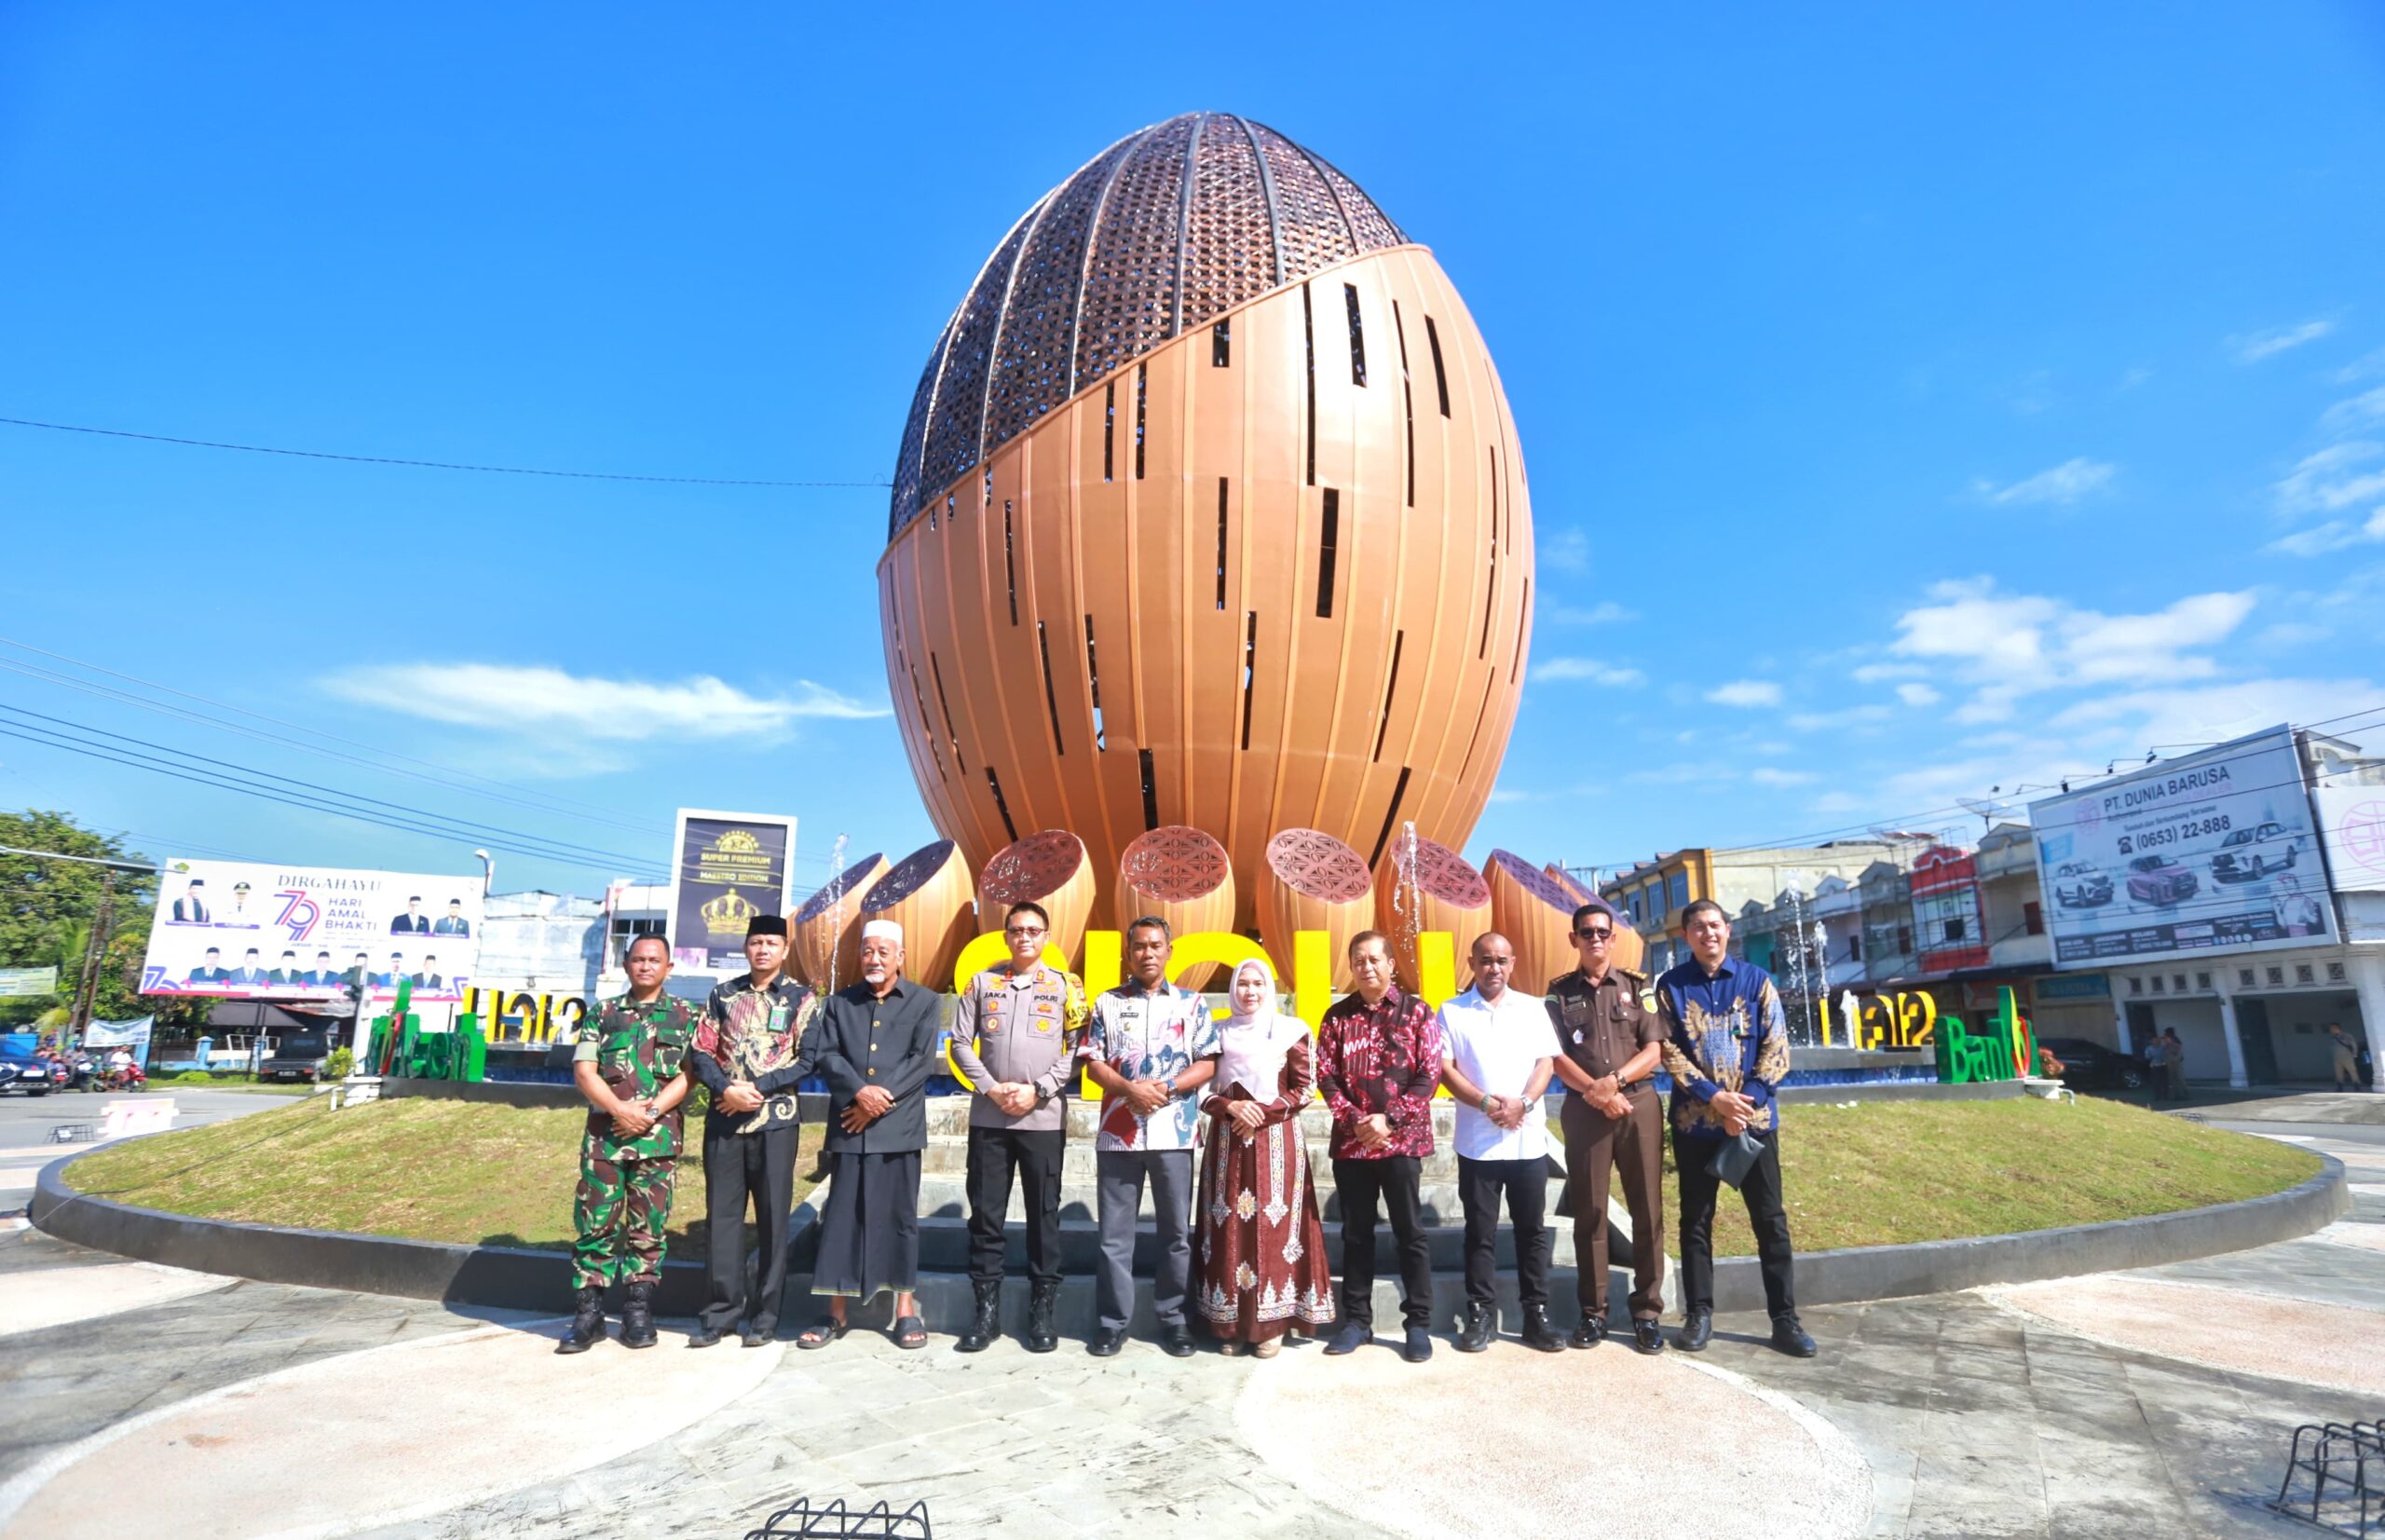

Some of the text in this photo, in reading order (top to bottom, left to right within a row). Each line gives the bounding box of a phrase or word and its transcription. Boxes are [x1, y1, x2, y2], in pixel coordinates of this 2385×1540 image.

[2104, 766, 2230, 812] PT. DUNIA BARUSA
[2136, 814, 2231, 851] (0653) 22-888
[701, 852, 771, 865] SUPER PREMIUM
[700, 871, 737, 881] MAESTRO
[278, 874, 381, 892] DIRGAHAYU
[328, 897, 362, 907] HARI
[273, 890, 320, 941] 79
[327, 908, 365, 920] AMAL
[324, 920, 377, 931] BHAKTI
[983, 991, 1007, 1000] JAKA
[1033, 994, 1058, 1002] POLRI
